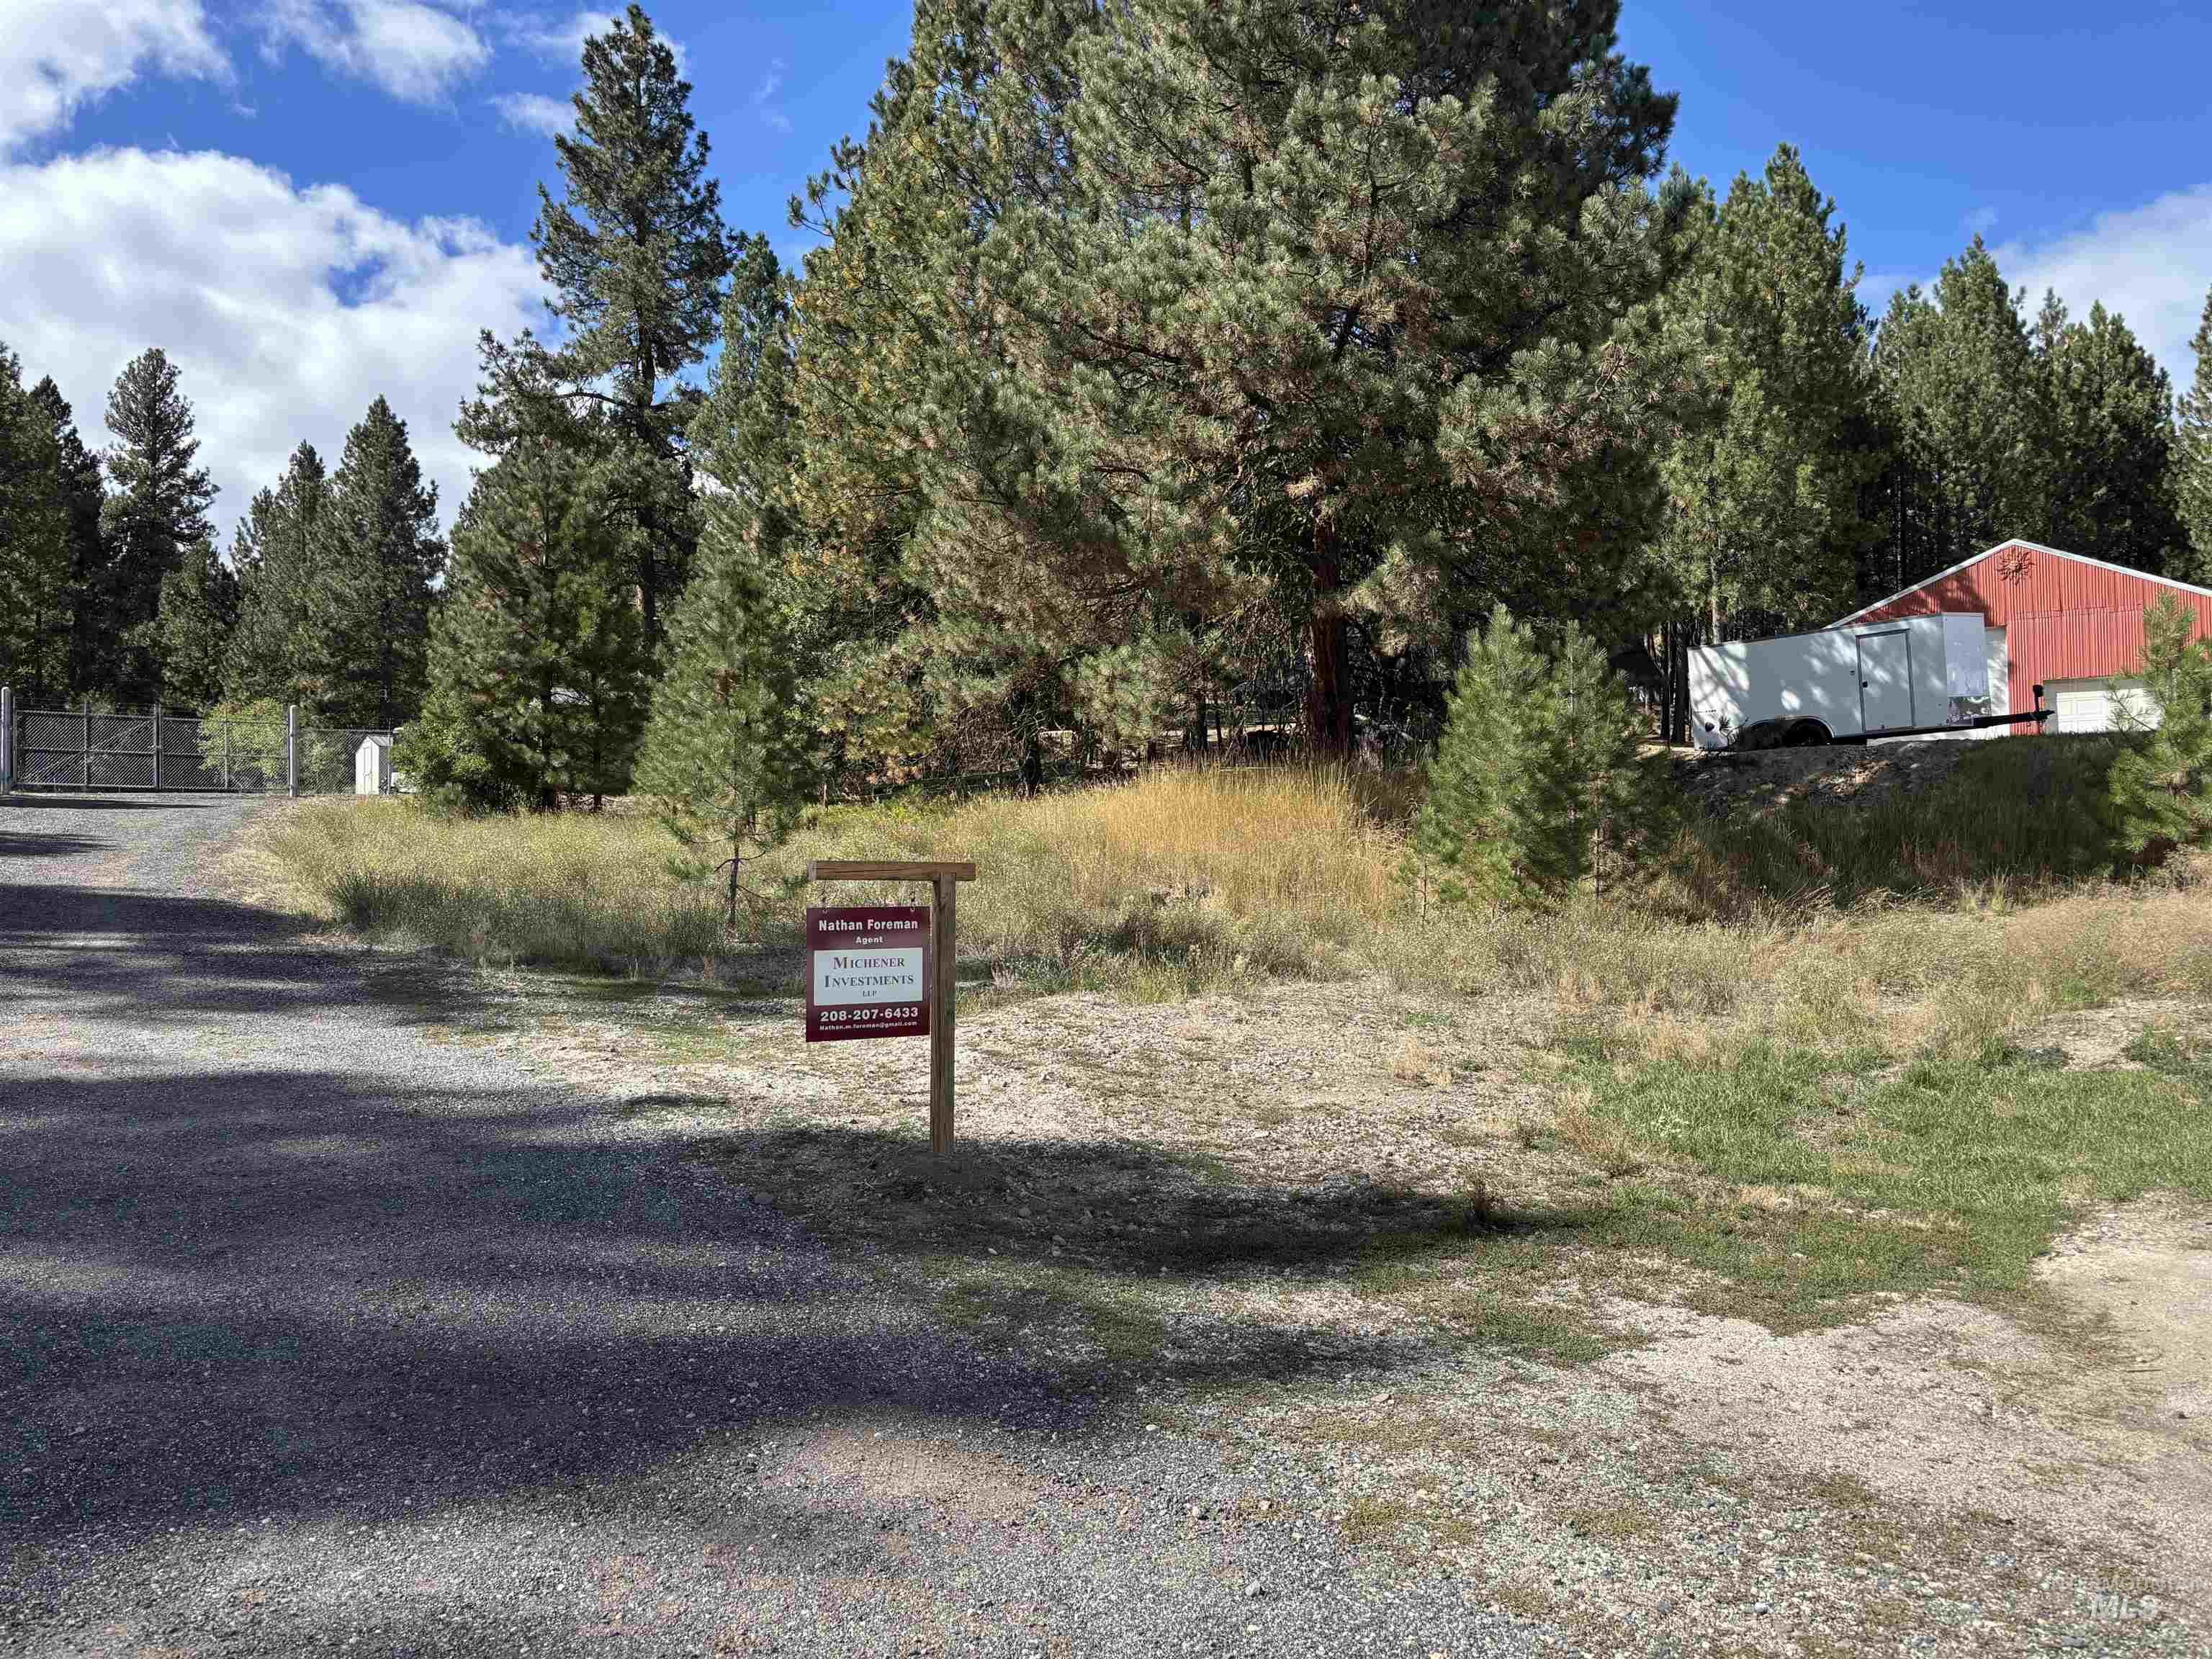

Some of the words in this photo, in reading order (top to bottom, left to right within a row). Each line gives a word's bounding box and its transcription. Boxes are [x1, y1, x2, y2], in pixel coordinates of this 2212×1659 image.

[819, 920, 863, 931] Nathan
[867, 919, 918, 930] Foreman
[833, 956, 905, 969] MICHENER
[824, 974, 914, 987] INVESTMENTS
